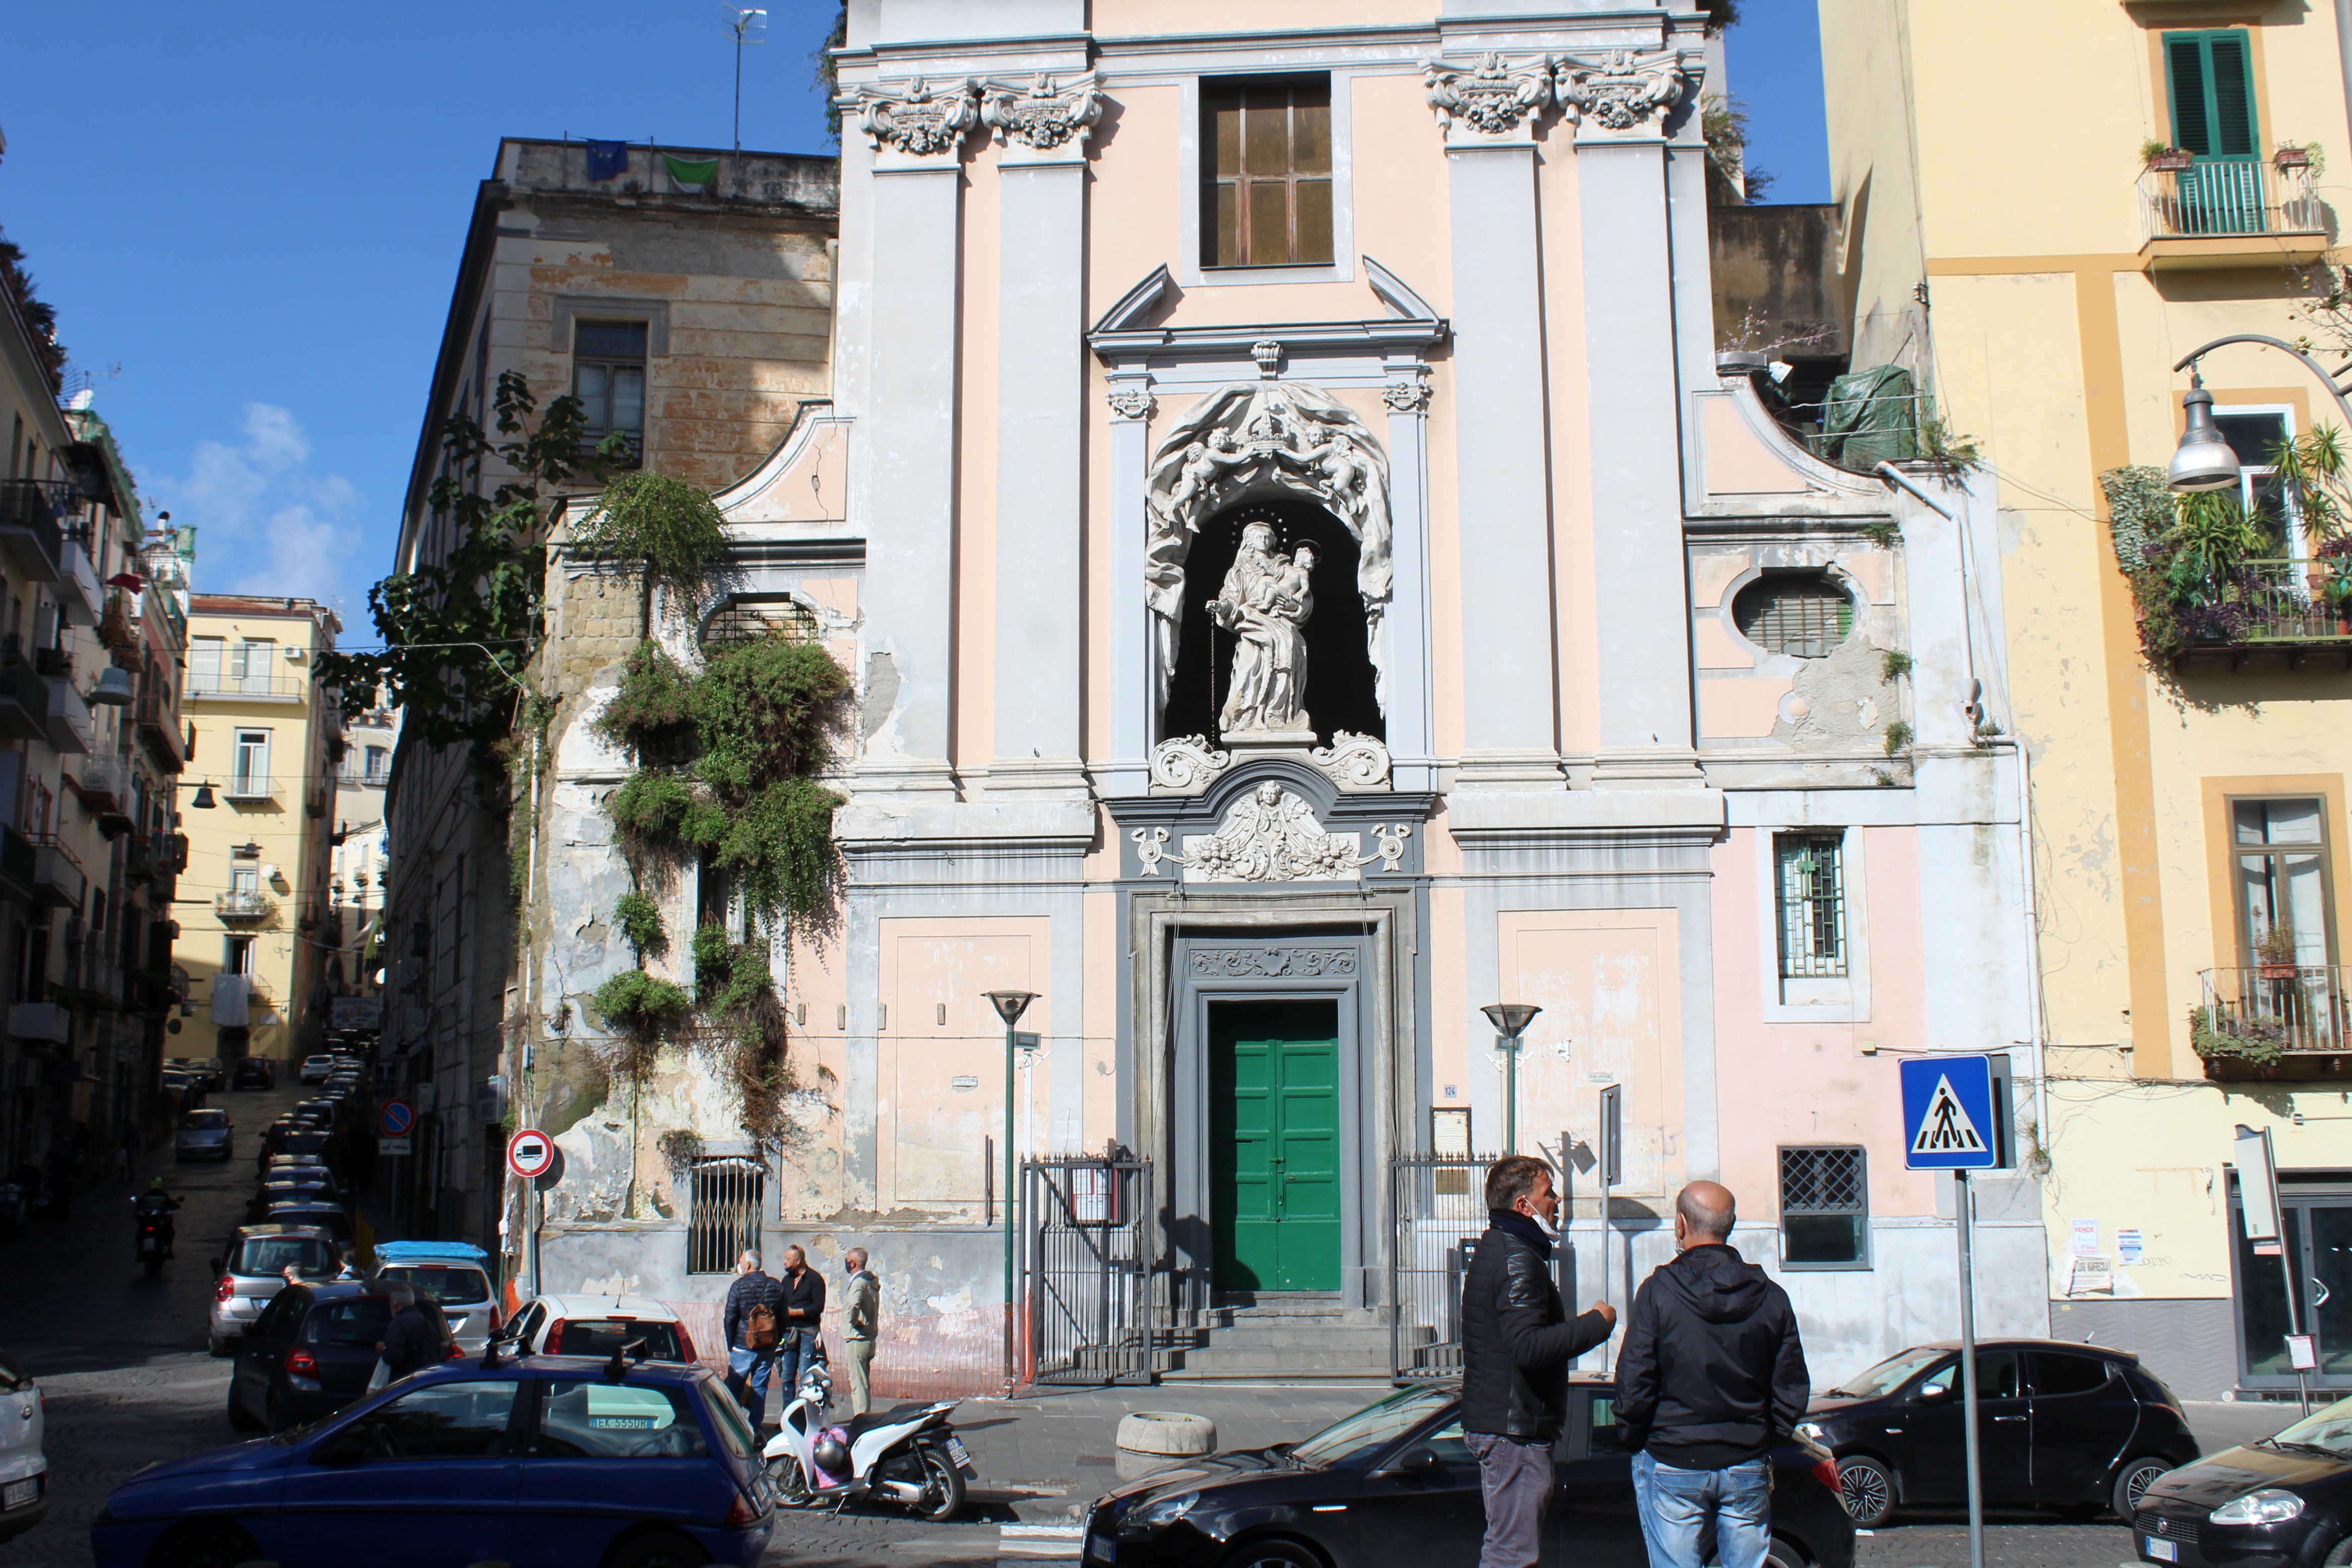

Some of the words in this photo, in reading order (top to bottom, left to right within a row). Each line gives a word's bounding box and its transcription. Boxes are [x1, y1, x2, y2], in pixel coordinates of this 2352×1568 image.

[379, 1062, 393, 1080] T
[1445, 1087, 1455, 1095] 124
[598, 1418, 609, 1427] EK
